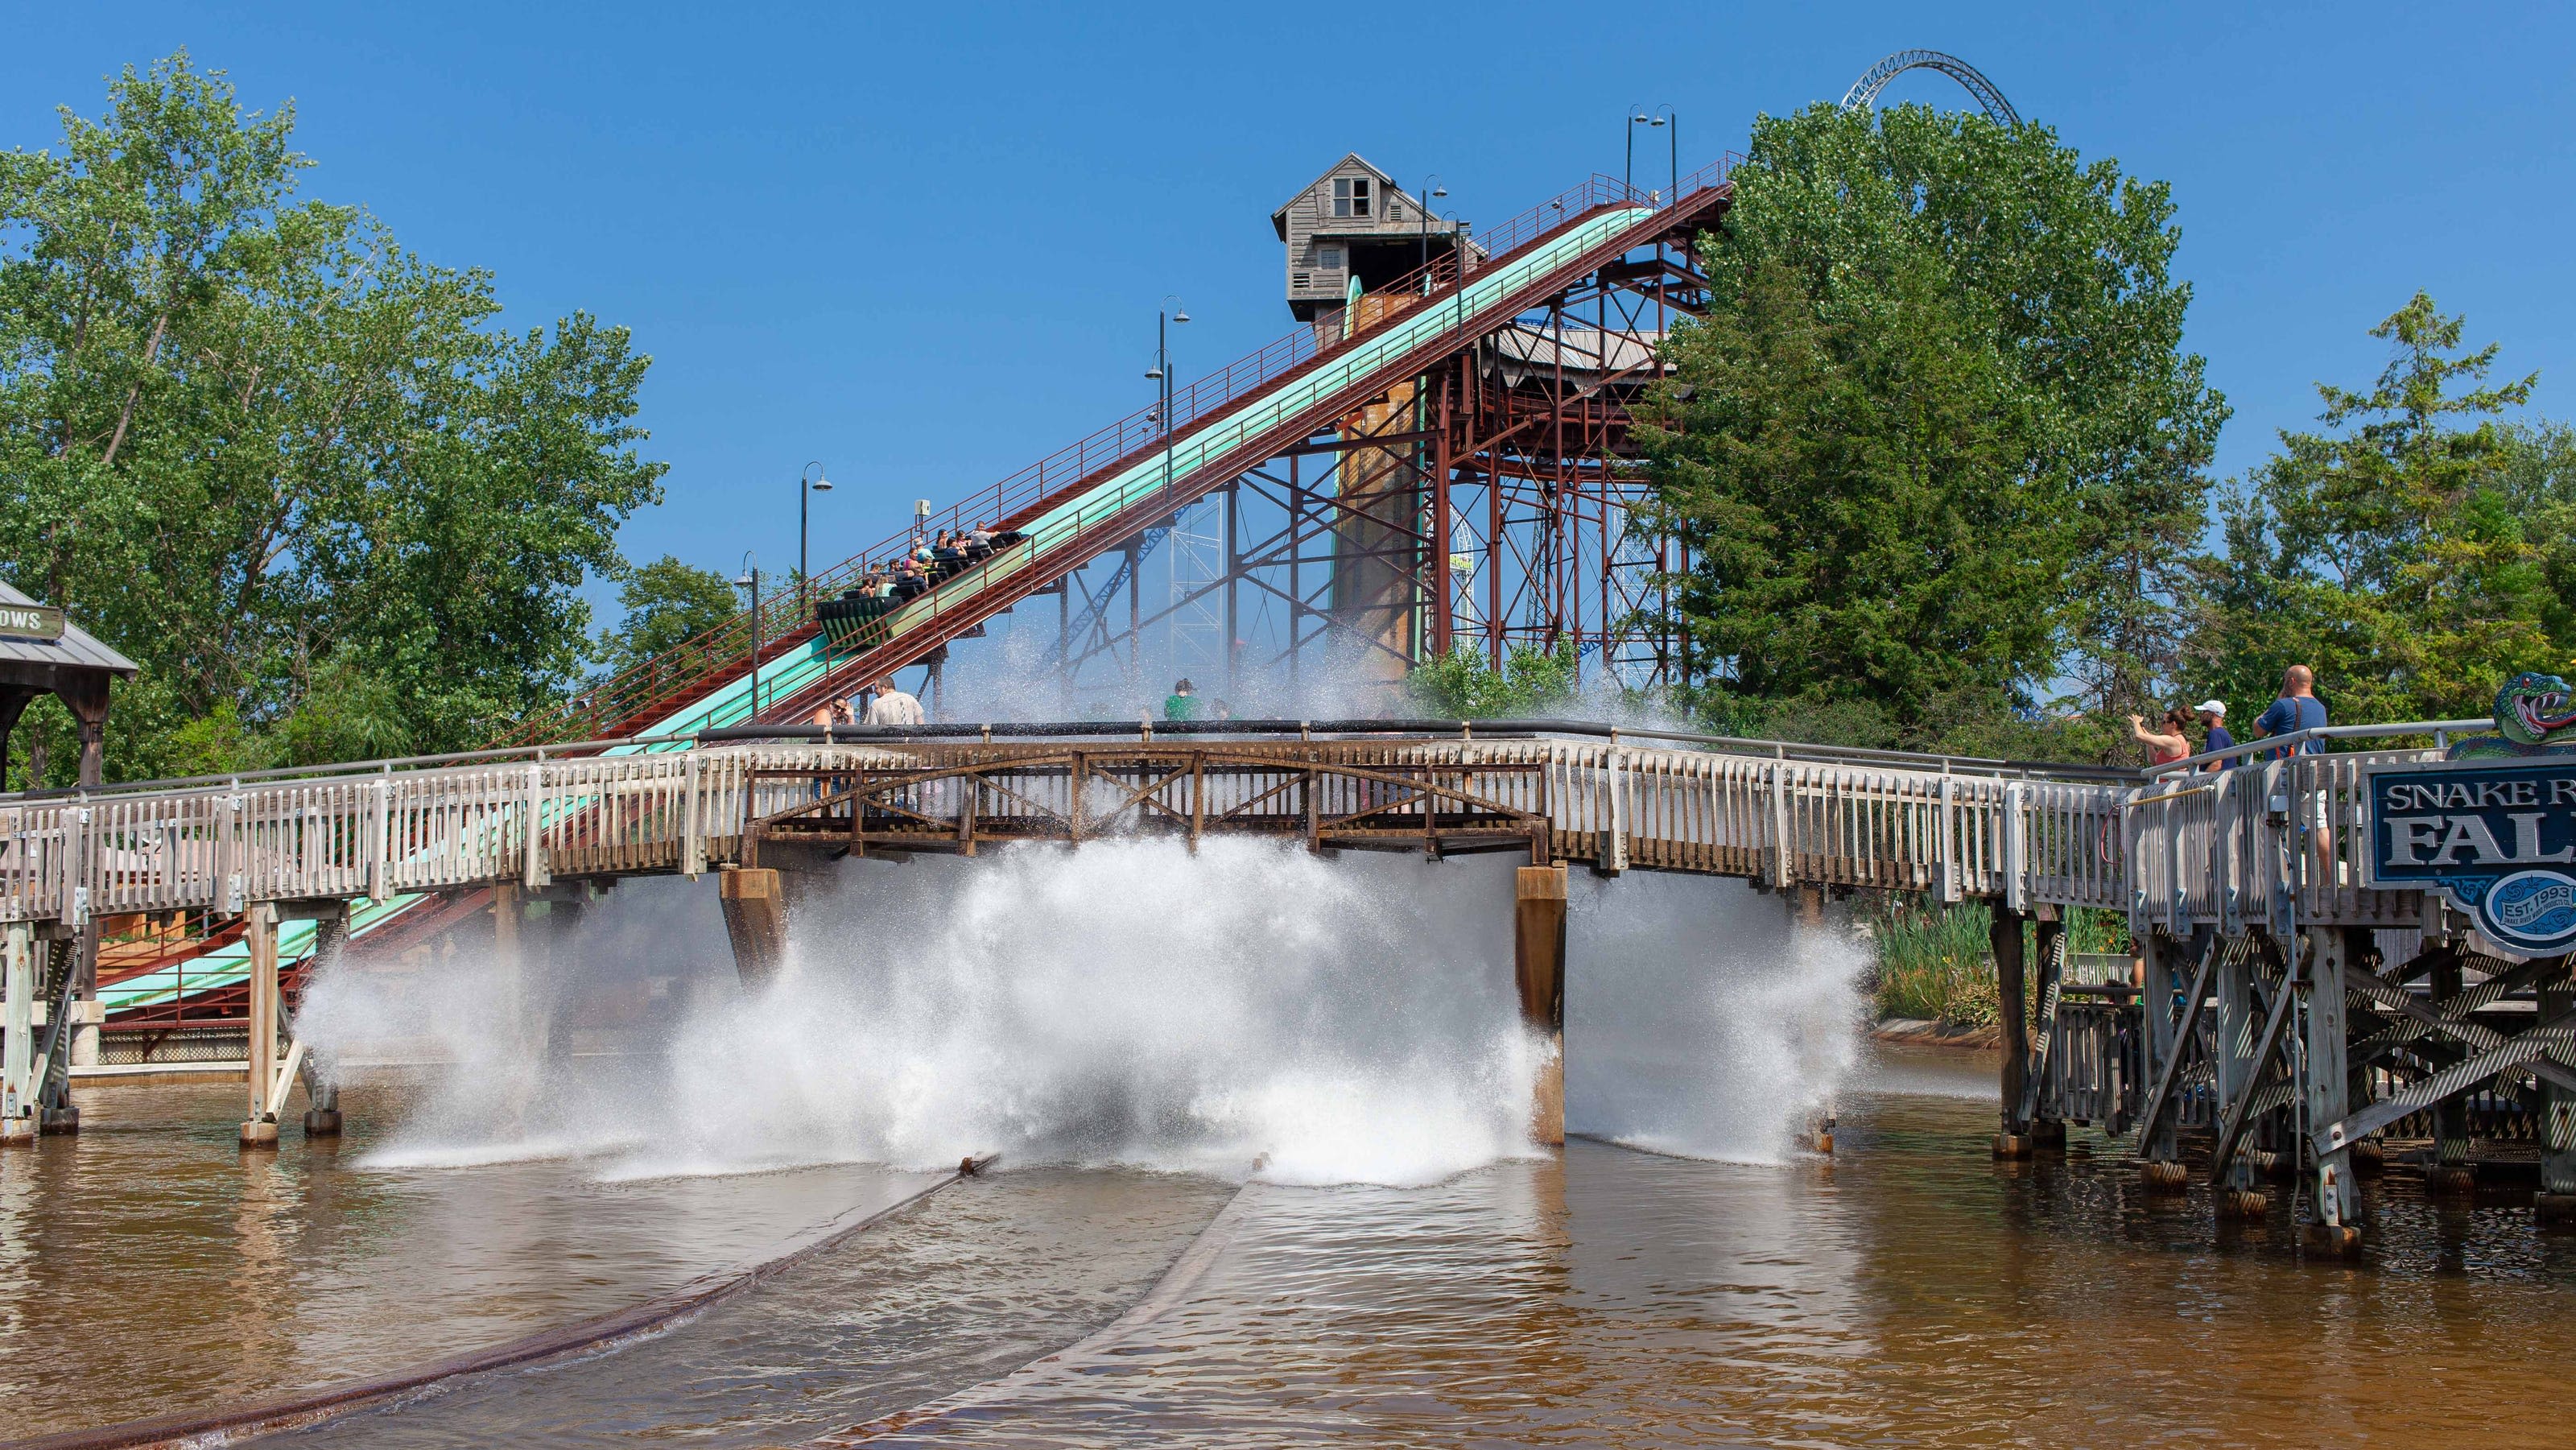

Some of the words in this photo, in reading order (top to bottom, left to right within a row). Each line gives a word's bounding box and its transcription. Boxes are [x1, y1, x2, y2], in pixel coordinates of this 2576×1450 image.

[2387, 780, 2540, 810] SNAKE
[2383, 812, 2576, 865] FAL
[2533, 887, 2570, 907] 1993
[2519, 915, 2532, 923] RIVER
[2532, 907, 2543, 919] WOOD
[2543, 899, 2564, 911] PRODUCTS
